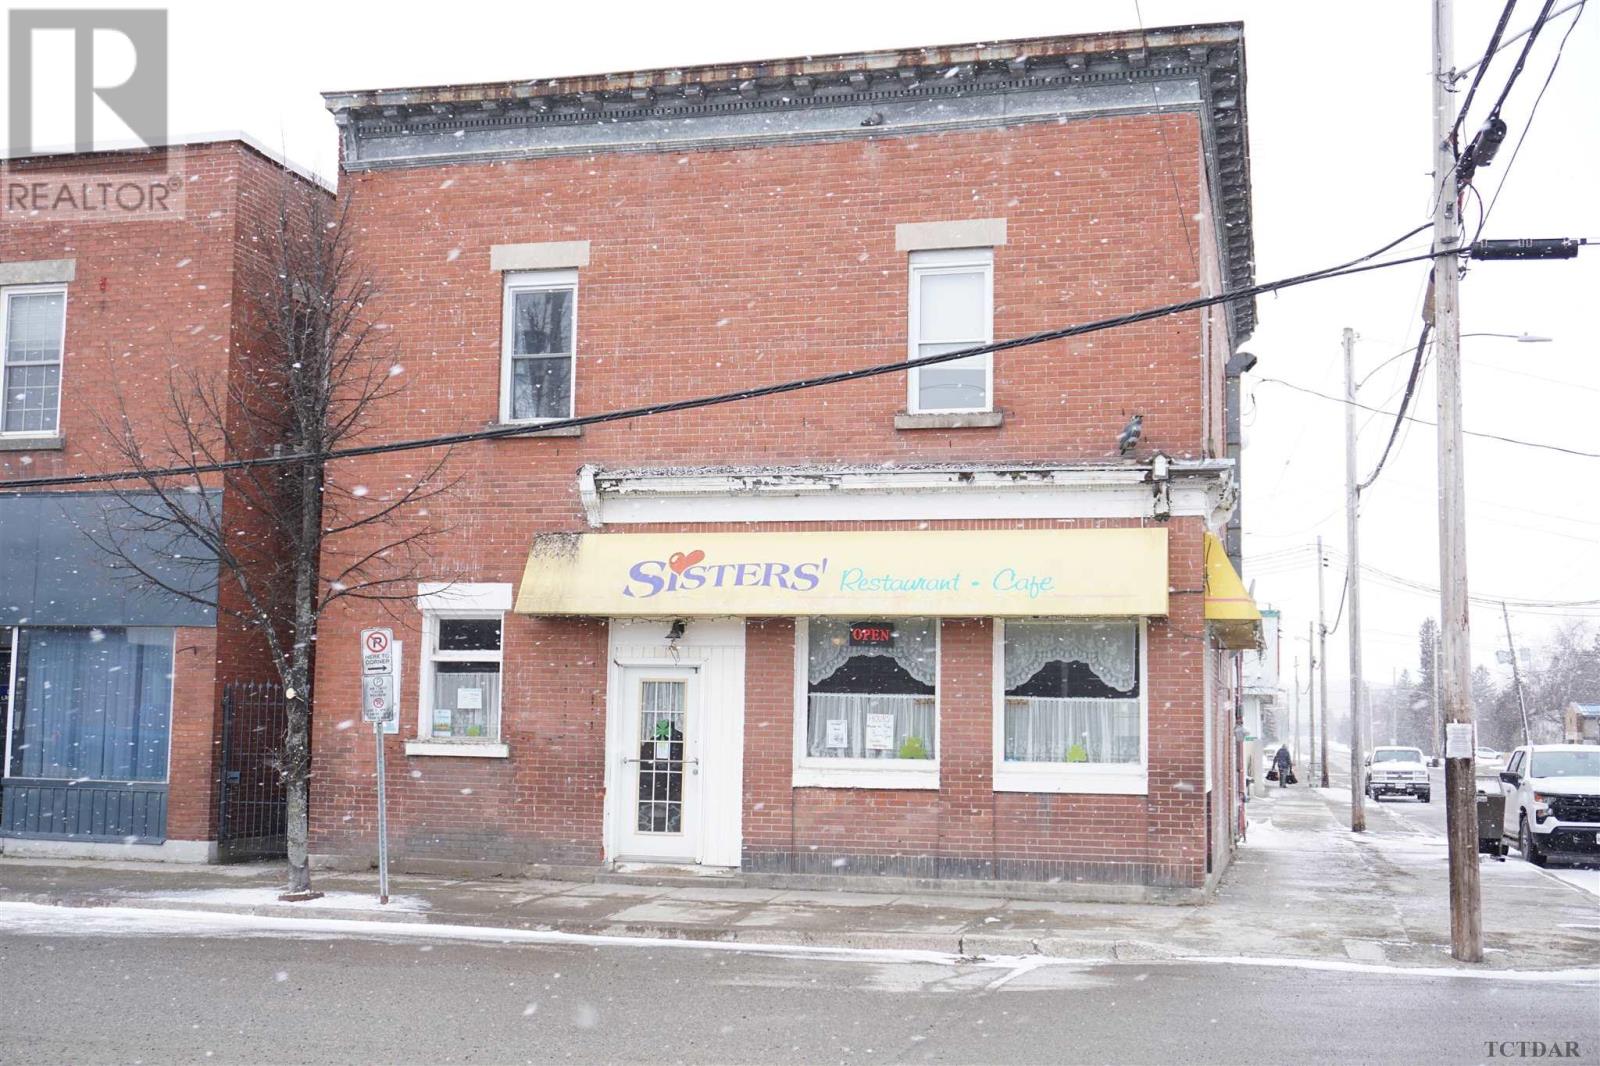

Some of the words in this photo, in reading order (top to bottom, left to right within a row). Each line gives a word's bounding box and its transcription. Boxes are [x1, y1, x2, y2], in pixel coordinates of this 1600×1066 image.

[840, 567, 960, 592] Restaurant
[993, 568, 1055, 598] Cafe
[853, 628, 890, 641] OPEN
